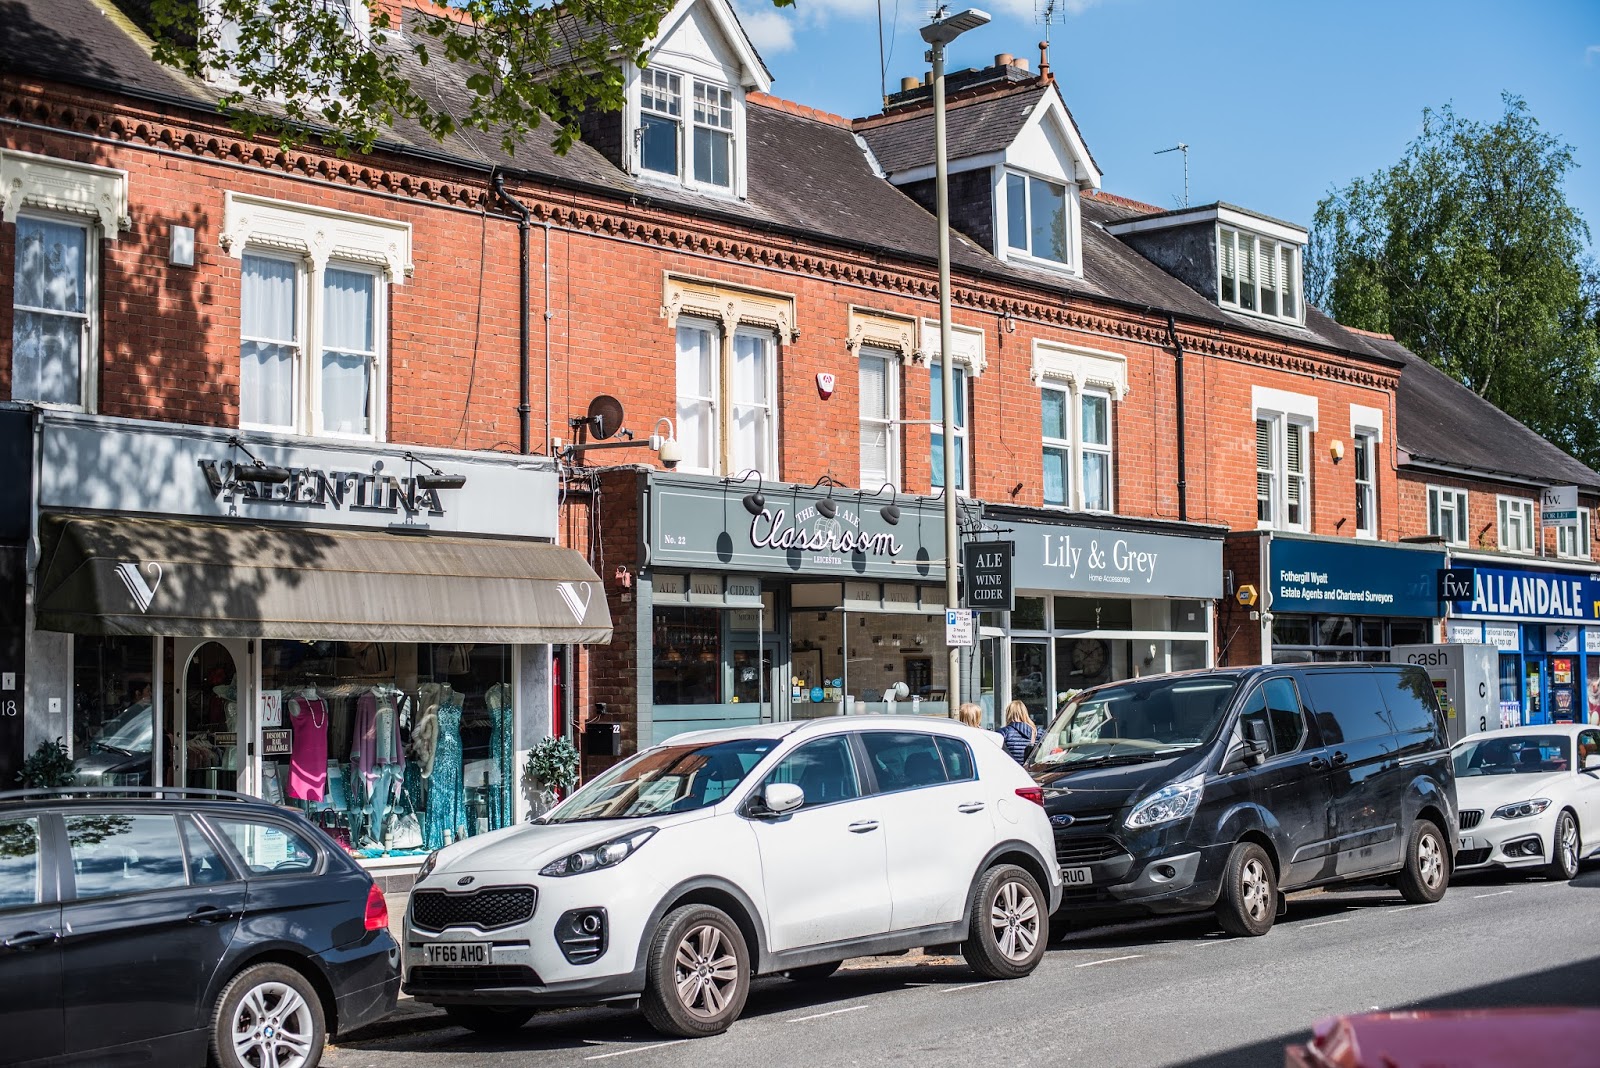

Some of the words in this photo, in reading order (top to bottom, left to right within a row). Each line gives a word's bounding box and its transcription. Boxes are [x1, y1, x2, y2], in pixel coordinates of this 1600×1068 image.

[796, 506, 815, 524] THE
[842, 511, 861, 528] ALE
[750, 508, 904, 556] Classroom
[664, 535, 676, 544] No.
[678, 536, 686, 545] 22
[813, 555, 842, 565] LEICESTER
[975, 553, 1003, 568] ALE
[1042, 534, 1082, 579] Lily
[1088, 540, 1106, 569] &
[1113, 540, 1158, 583] Grey
[976, 575, 1002, 585] WINE
[1088, 574, 1103, 582] Home
[1103, 574, 1131, 584] Accessories
[1280, 570, 1310, 584] Fothergill
[1311, 572, 1328, 585] Wyatt
[660, 583, 677, 593] ALE
[695, 584, 718, 595] WINE
[730, 585, 755, 596] CIDER
[1442, 573, 1470, 597] fw.
[856, 591, 870, 601] ALE
[974, 589, 1003, 600] CIDER
[1281, 586, 1300, 598] Estate
[1301, 587, 1323, 600] Agents
[1324, 589, 1336, 600] and
[1336, 589, 1364, 601] Chartered
[1365, 590, 1393, 604] Surveyors
[1471, 573, 1583, 617] ALLANDALE
[949, 612, 955, 624] P
[1502, 629, 1516, 638] lottery
[1408, 649, 1448, 666] cash
[2, 700, 17, 717] 18
[262, 696, 281, 722] 75%
[613, 724, 620, 734] 22
[1062, 870, 1085, 883] RUO
[428, 945, 458, 962] YF66
[460, 945, 484, 962] AHO
